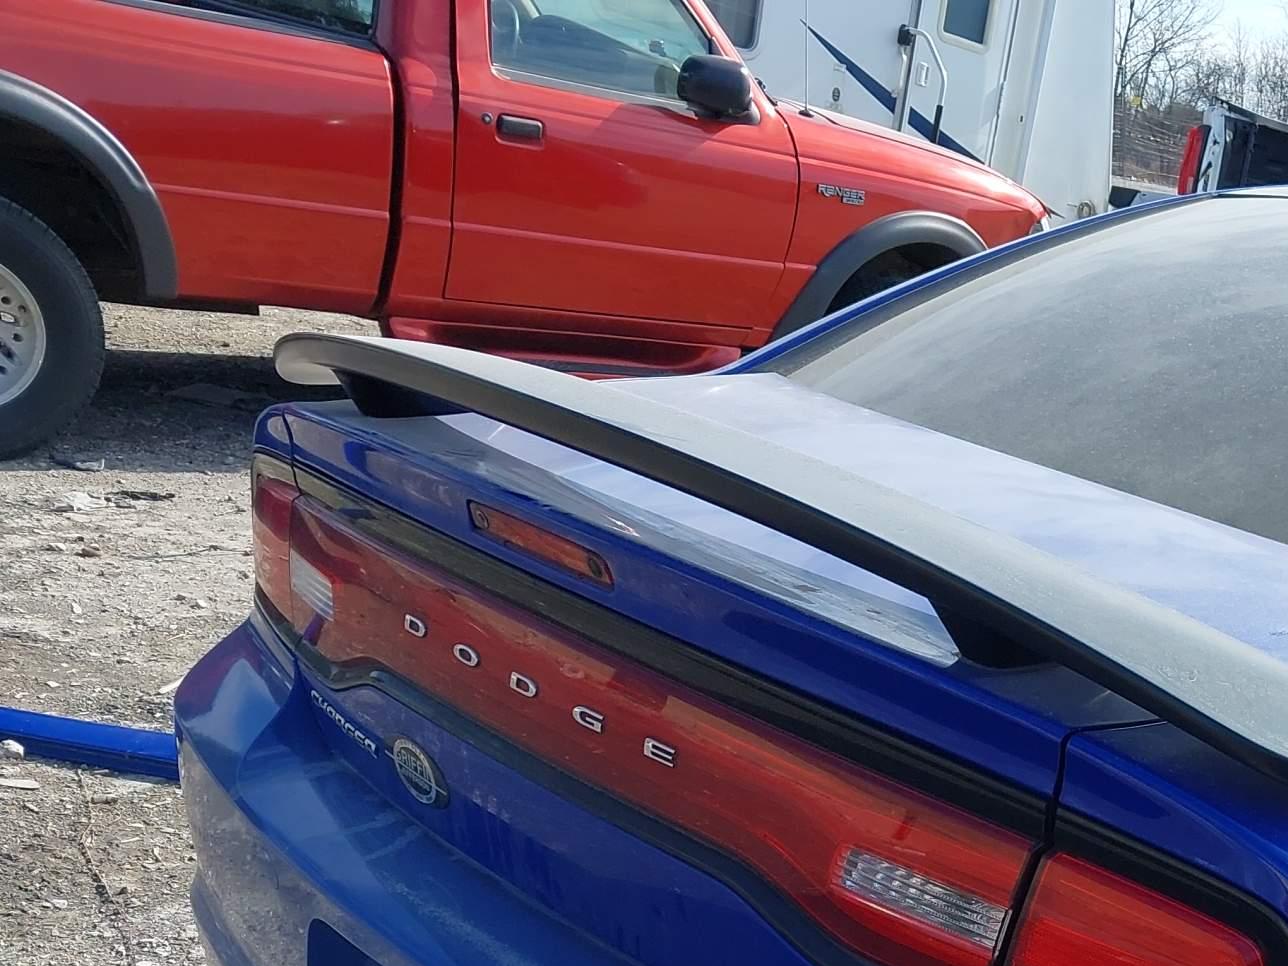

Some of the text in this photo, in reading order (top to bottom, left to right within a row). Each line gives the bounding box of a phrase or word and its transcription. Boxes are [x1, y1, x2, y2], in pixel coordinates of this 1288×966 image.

[818, 184, 866, 201] RANGER
[310, 690, 378, 760] CHARGER
[405, 614, 677, 768] DODGE
